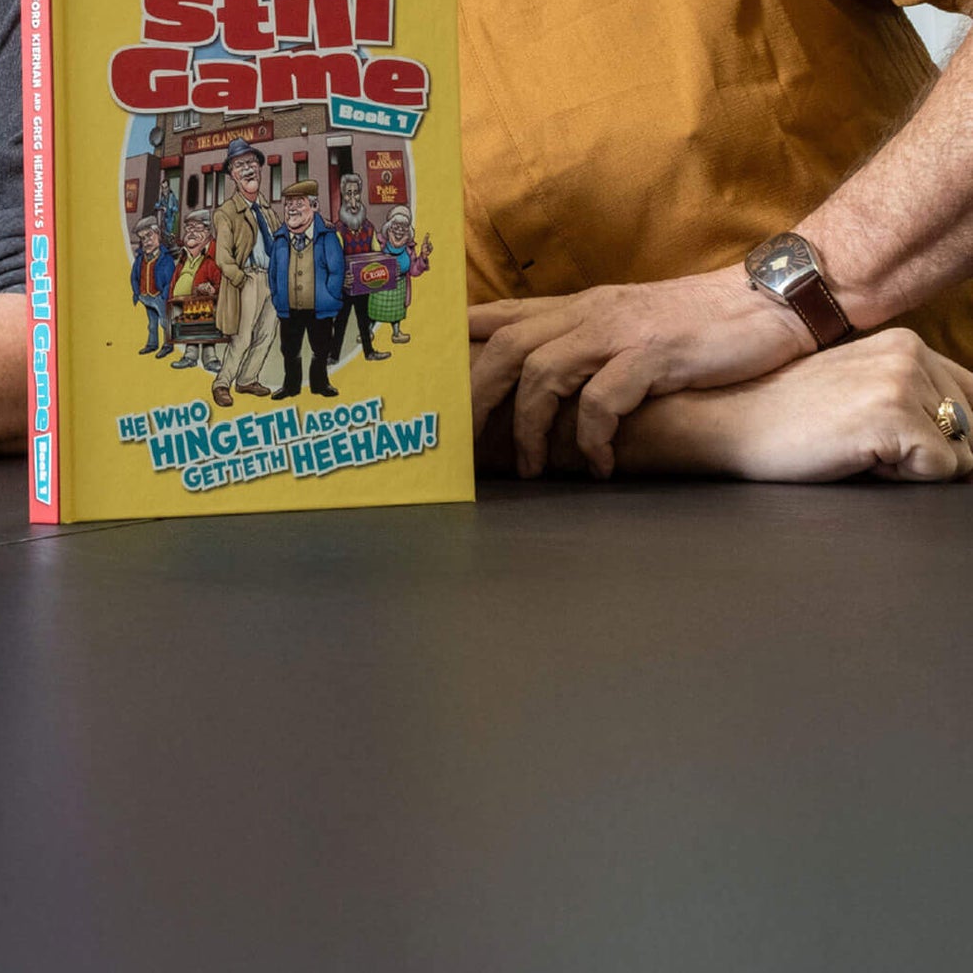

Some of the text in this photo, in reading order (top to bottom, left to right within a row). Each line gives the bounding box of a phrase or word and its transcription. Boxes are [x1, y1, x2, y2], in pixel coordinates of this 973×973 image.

[31, 33, 42, 88] KIERNAN
[110, 46, 427, 112] Game
[33, 92, 42, 112] AND
[338, 104, 409, 129] Book 1
[33, 116, 43, 150] GREG
[196, 136, 212, 149] THE
[377, 152, 391, 161] THE
[33, 154, 44, 229] HEMPHILL'S
[31, 235, 51, 320] Still
[33, 322, 51, 432] Game
[118, 401, 208, 438] HE WHO
[149, 399, 380, 467] HINGETH ABOOT
[38, 441, 48, 482] Book
[183, 413, 437, 488] GETTETH HEEHAW!
